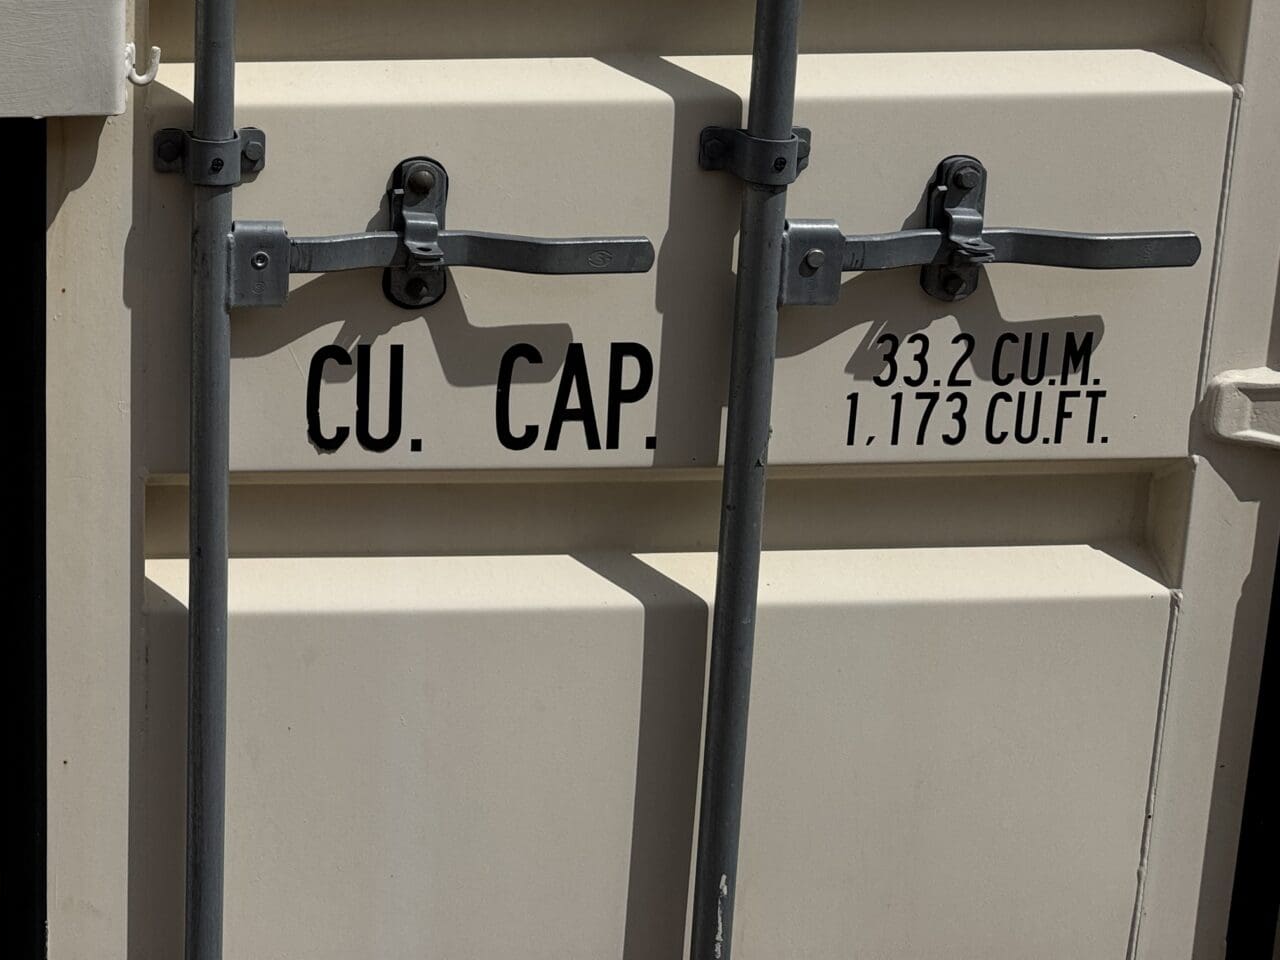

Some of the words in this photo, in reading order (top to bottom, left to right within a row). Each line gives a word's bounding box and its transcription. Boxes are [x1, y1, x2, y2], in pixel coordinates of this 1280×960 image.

[872, 332, 976, 387] 33.2
[306, 343, 422, 454] CU.
[495, 342, 657, 451] CAP.
[846, 391, 968, 446] 1,173
